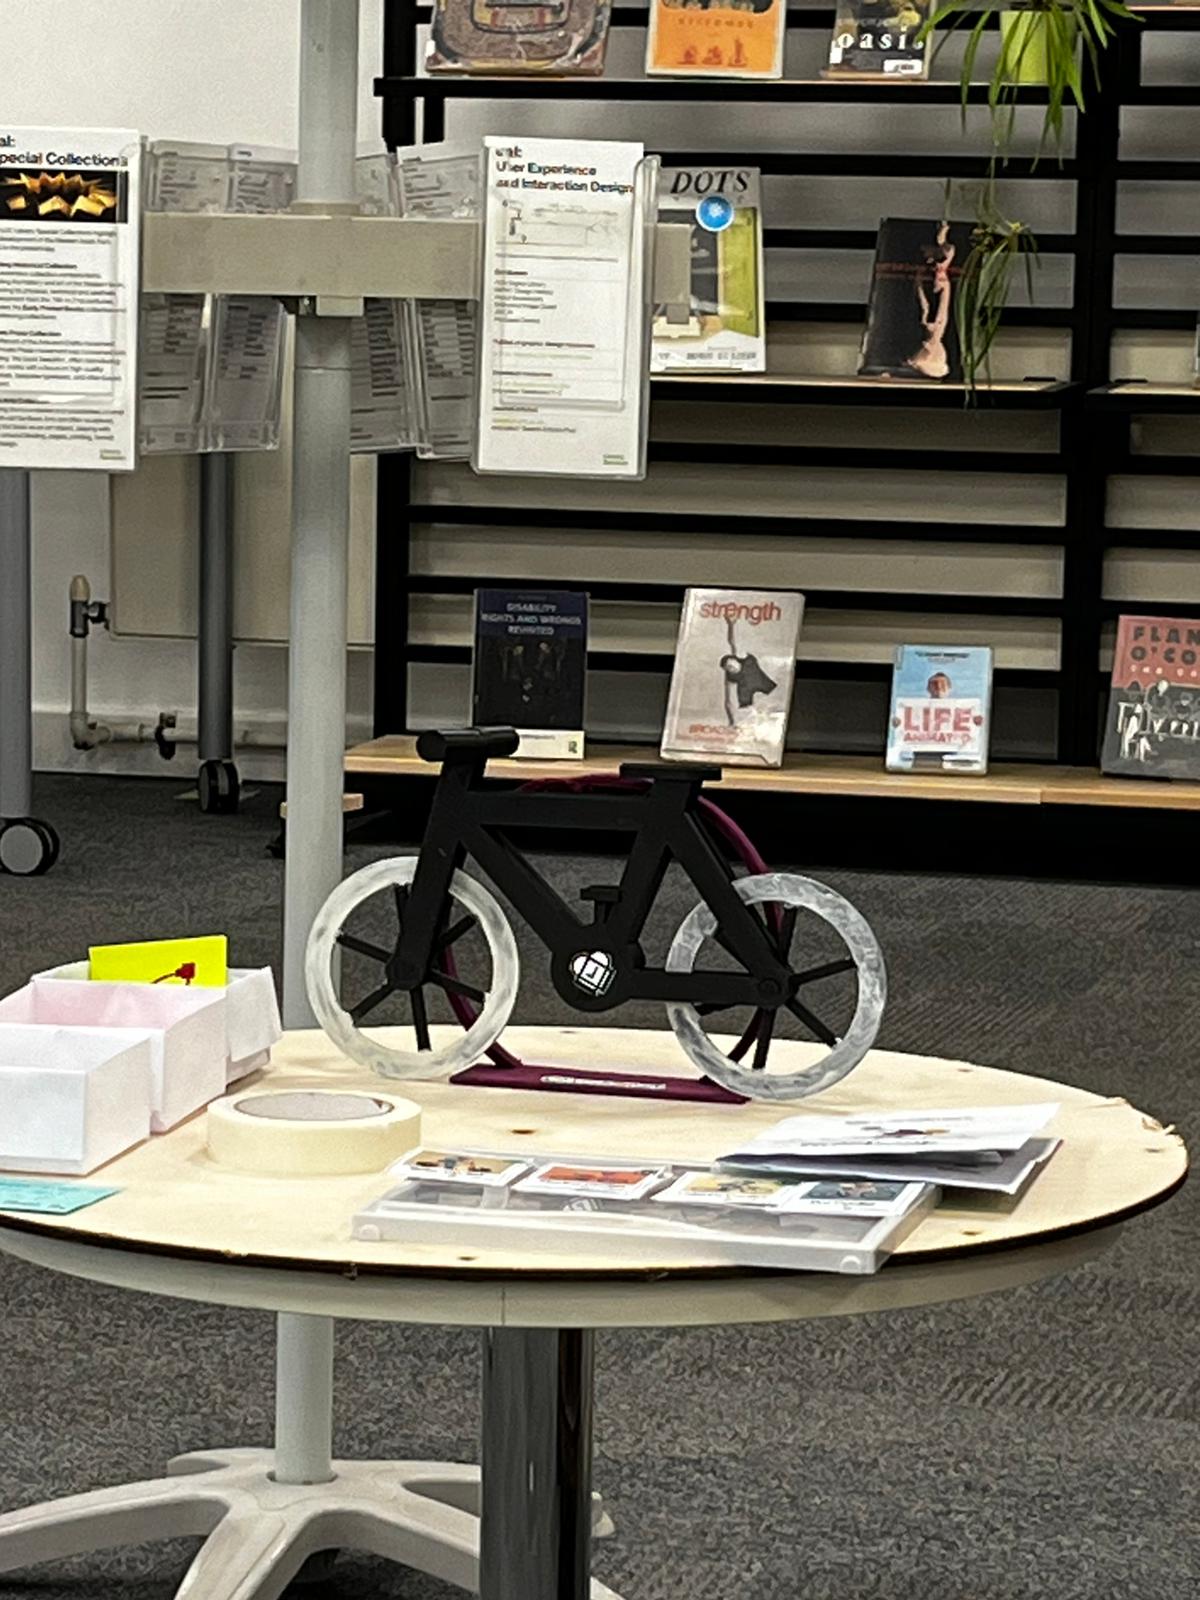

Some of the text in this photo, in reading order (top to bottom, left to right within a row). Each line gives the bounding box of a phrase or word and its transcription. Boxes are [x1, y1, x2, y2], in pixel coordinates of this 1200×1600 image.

[45, 151, 128, 167] Collections
[527, 162, 597, 176] Experience
[521, 178, 588, 192] Interaction
[670, 170, 751, 194] DOTS
[516, 615, 538, 624] AND
[700, 602, 782, 626] strength
[1133, 625, 1200, 646] FLAN
[1130, 646, 1197, 666] O'CO
[903, 706, 972, 732] LIFE
